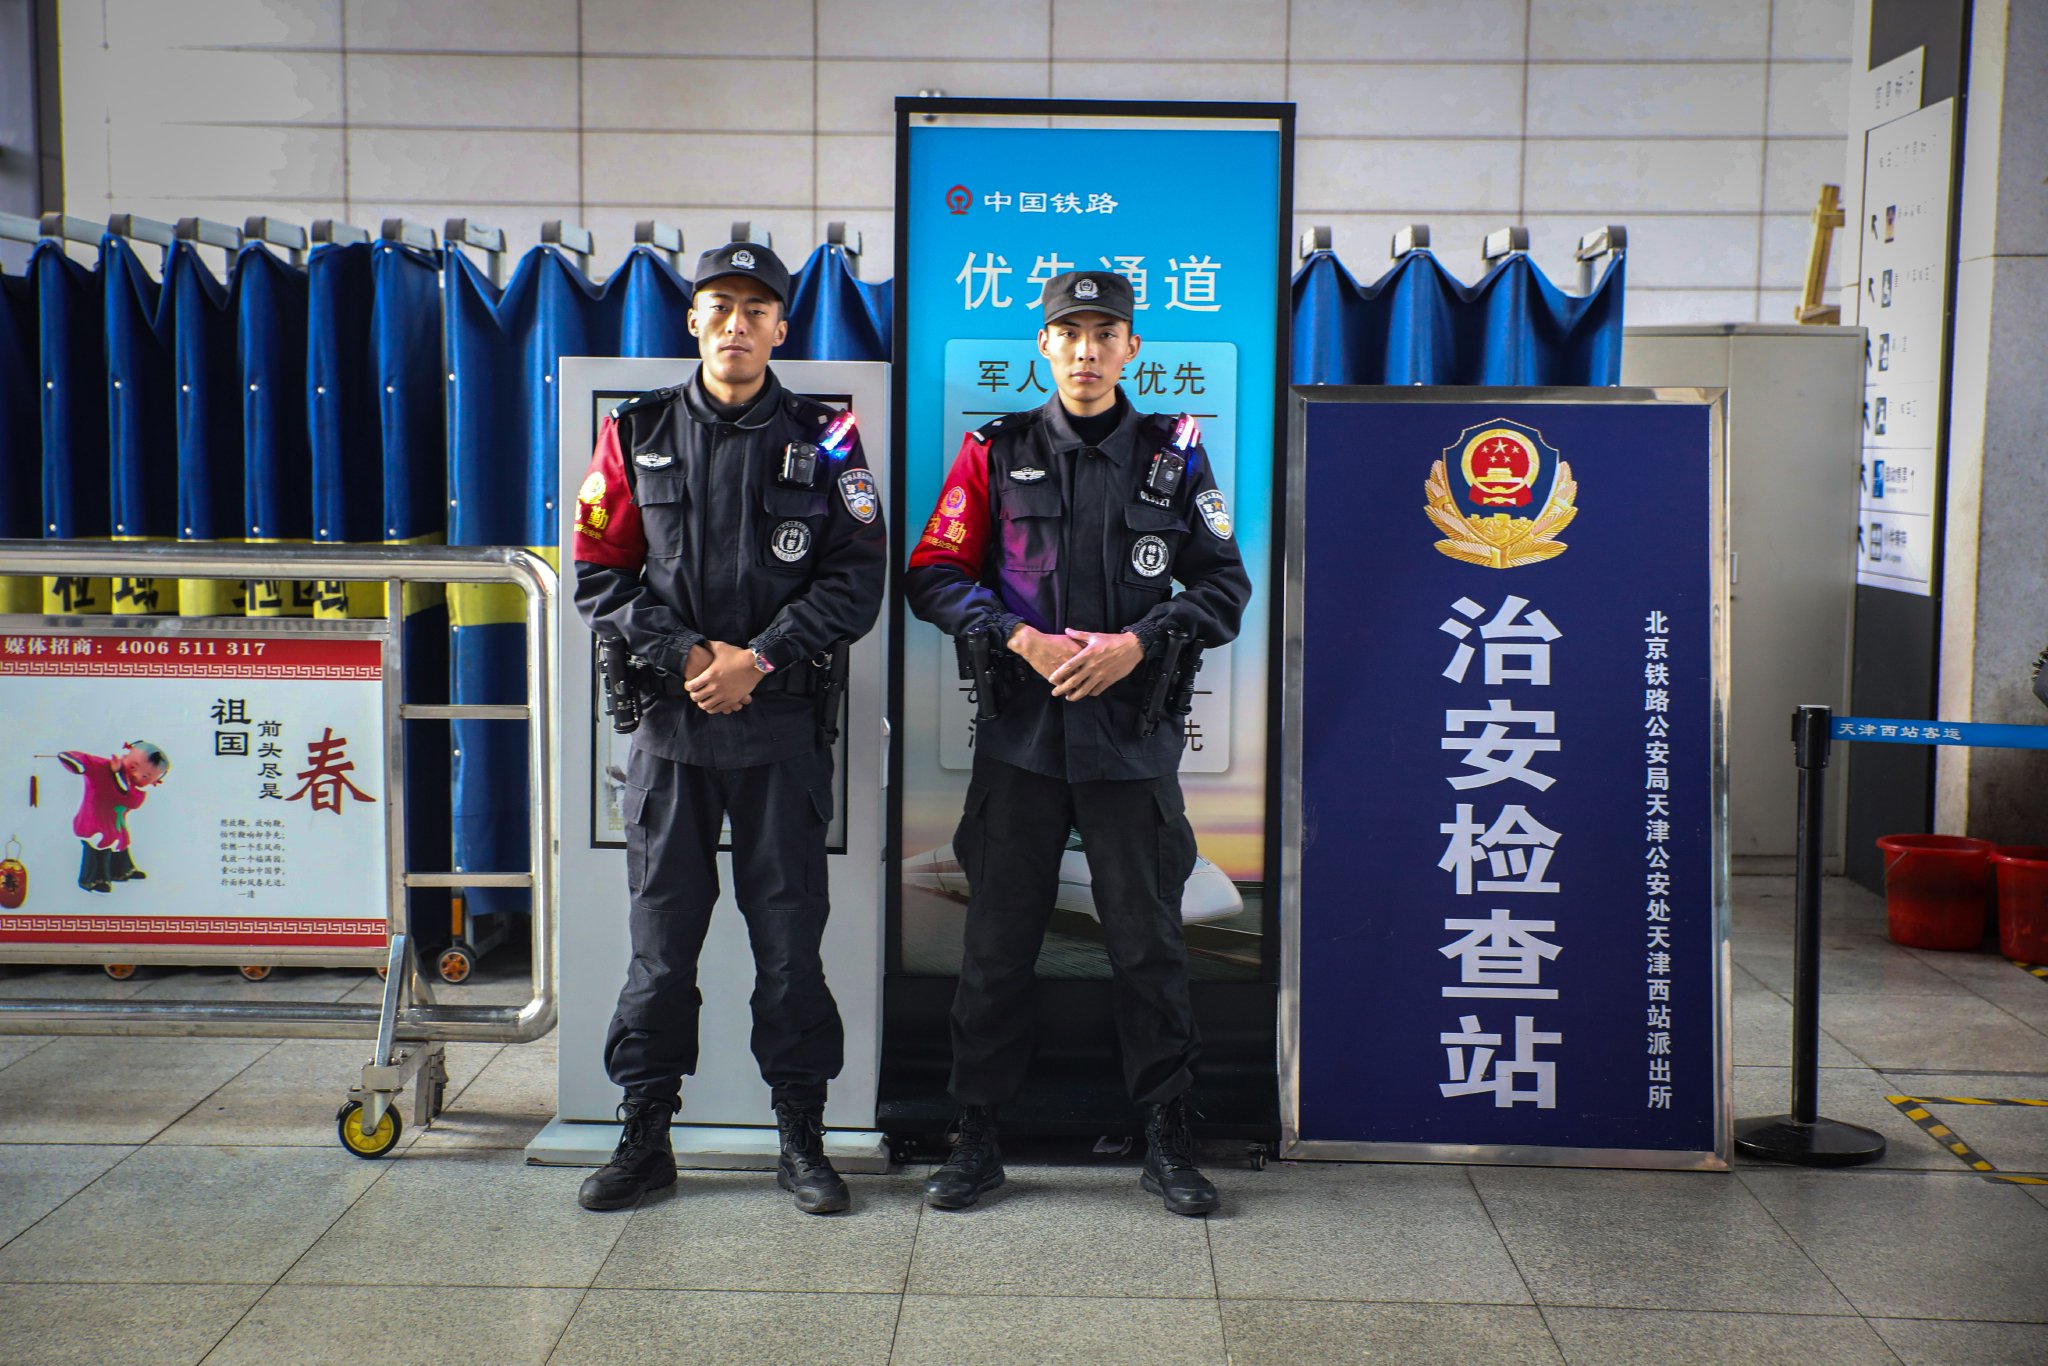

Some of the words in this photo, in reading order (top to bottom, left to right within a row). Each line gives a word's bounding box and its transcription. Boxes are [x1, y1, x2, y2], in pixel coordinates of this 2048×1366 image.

[984, 191, 1119, 215] 中国铁路
[978, 361, 1206, 396] 军人优先
[116, 640, 169, 654] 4006
[178, 641, 216, 655] 511
[226, 642, 266, 656] 317
[210, 698, 252, 756] 祖国
[1838, 722, 1962, 741] 天津西站客运
[257, 720, 283, 800] 前头尽是
[284, 727, 376, 815] 春
[1438, 595, 1563, 1109] 治安检查站
[1645, 610, 1672, 1109] 北京铁路公安局天津公安处天津西站派出所
